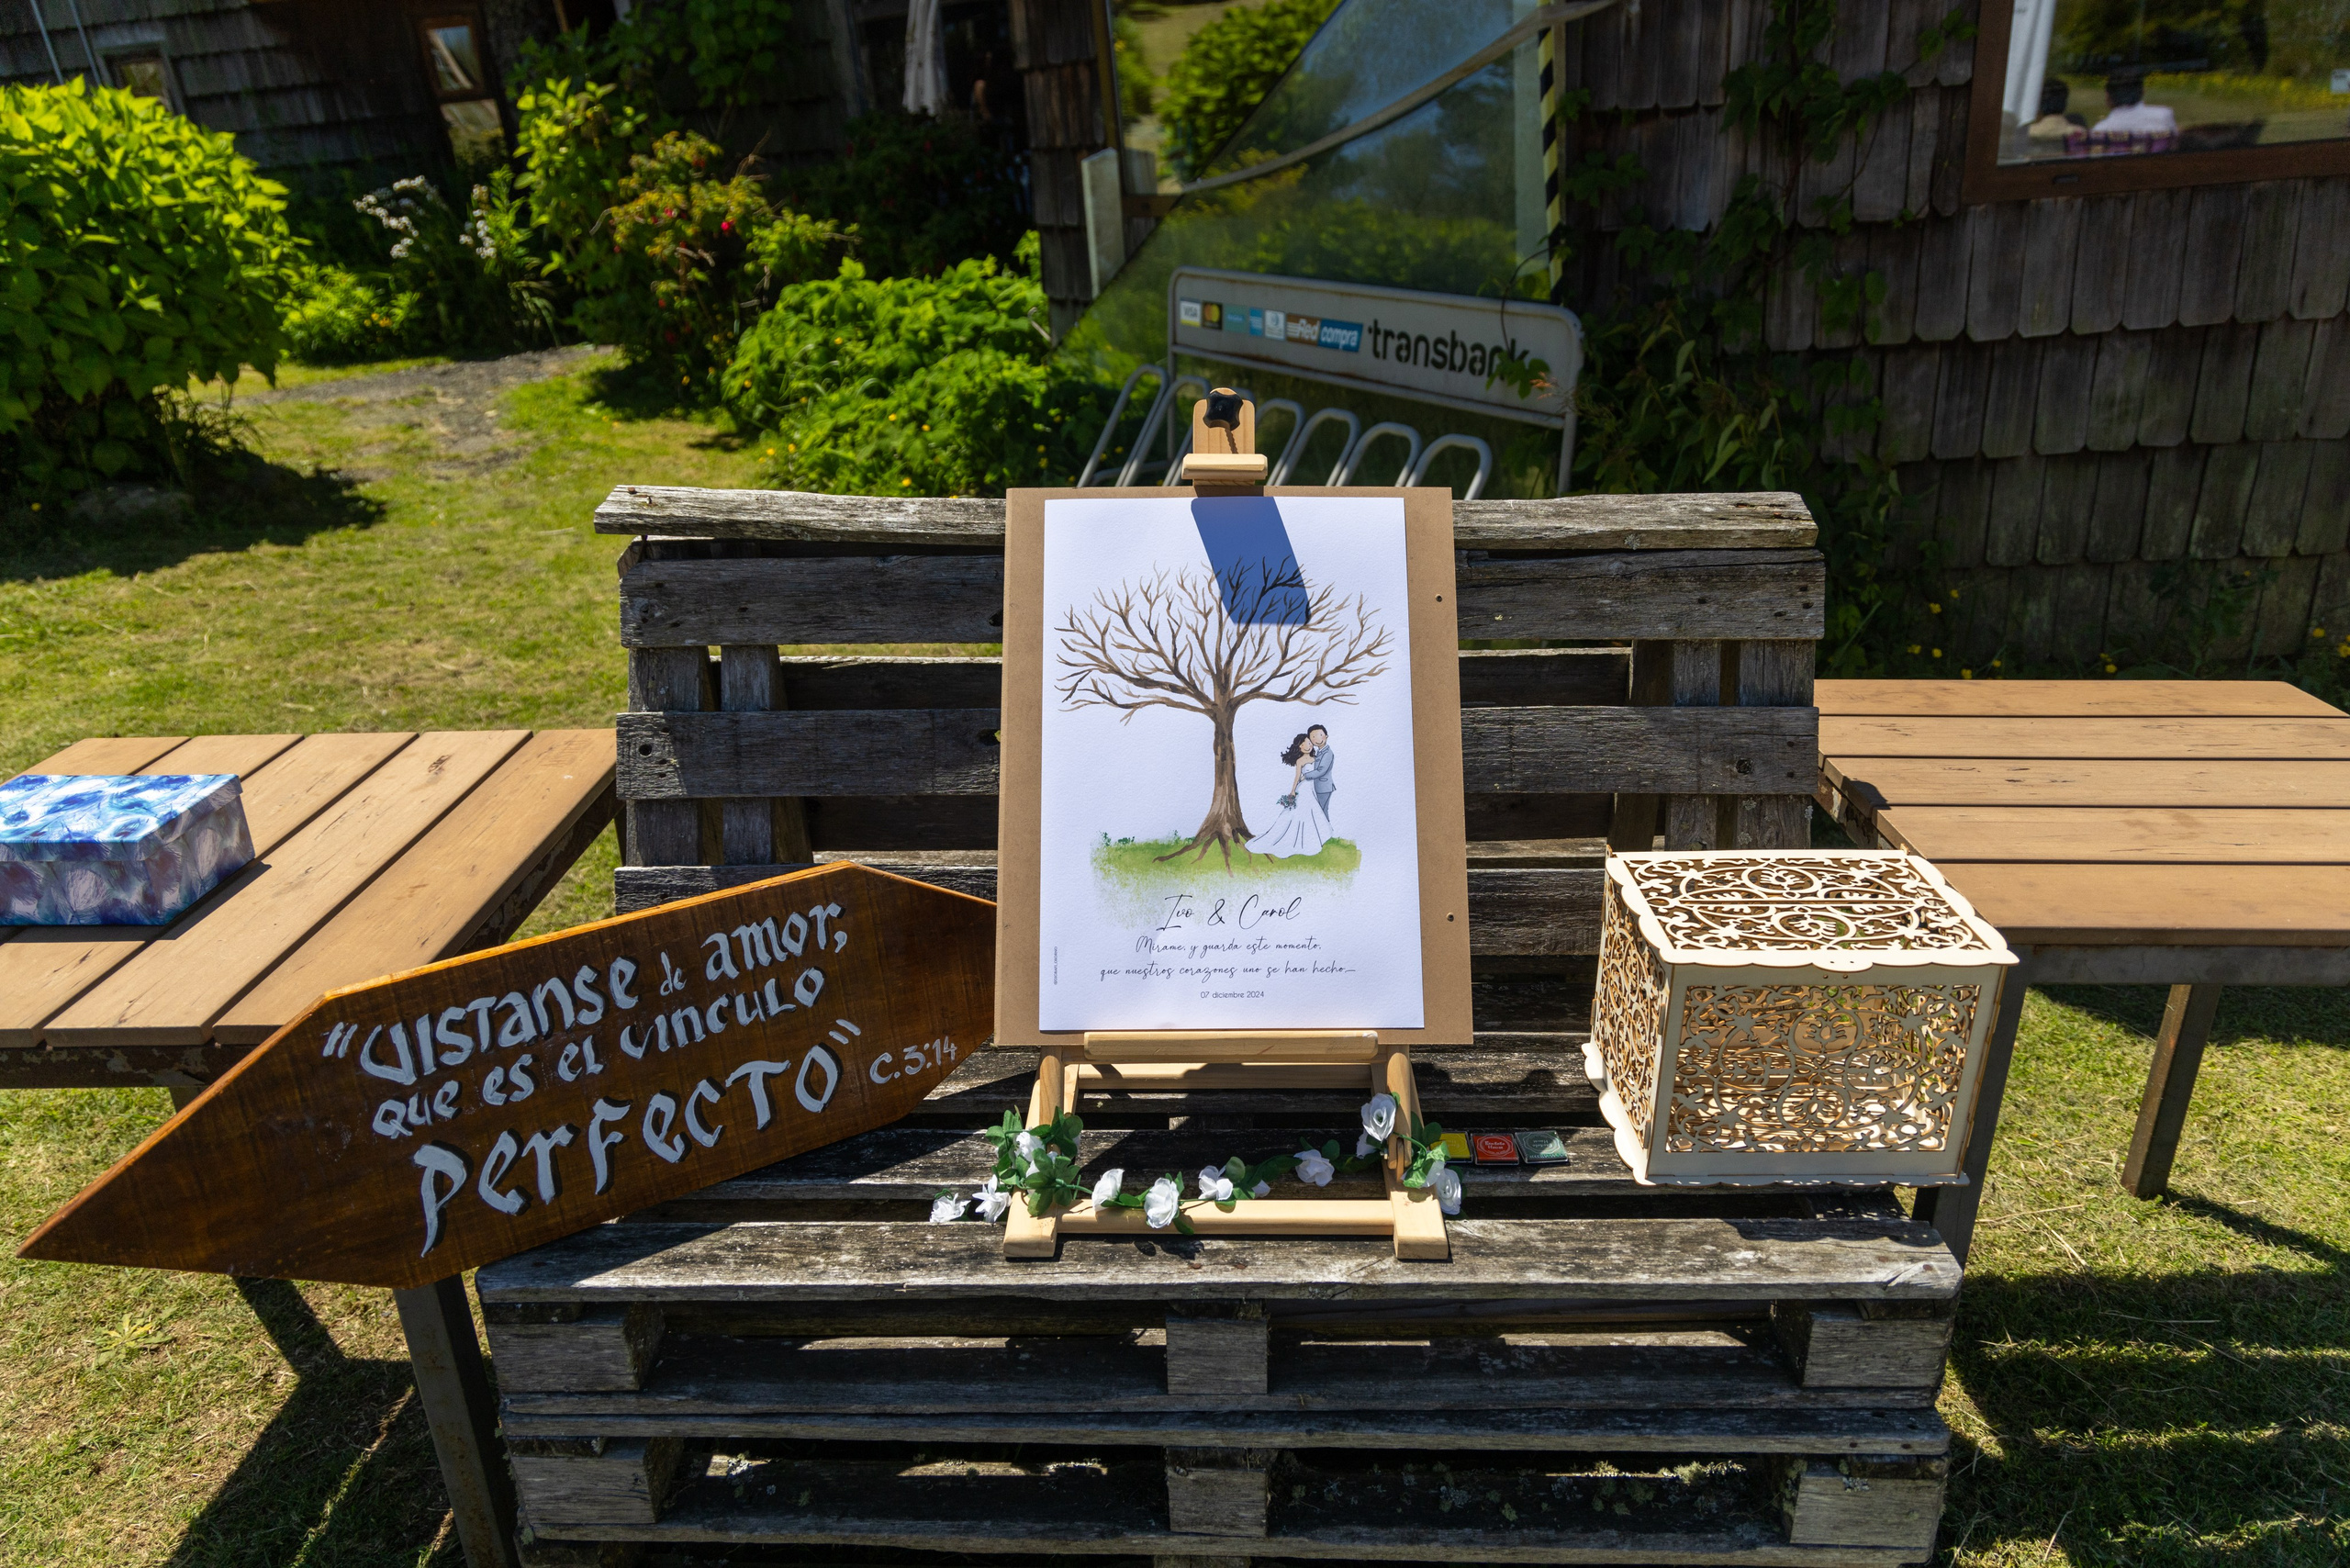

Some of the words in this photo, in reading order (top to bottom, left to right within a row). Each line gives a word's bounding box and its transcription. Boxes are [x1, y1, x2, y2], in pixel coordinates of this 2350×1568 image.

[1156, 893, 1194, 931] Ivo
[1207, 898, 1225, 925] &
[1239, 894, 1302, 929] Carol
[1188, 945, 1198, 958] y
[1200, 937, 1242, 958] guarda
[1246, 935, 1270, 955] este
[660, 951, 687, 996] de
[1101, 968, 1121, 981] que
[1125, 960, 1175, 980] nuestros
[1179, 967, 1237, 983] corazones
[1266, 966, 1281, 979] se
[1284, 960, 1307, 974] han
[1247, 991, 1264, 999] 2024
